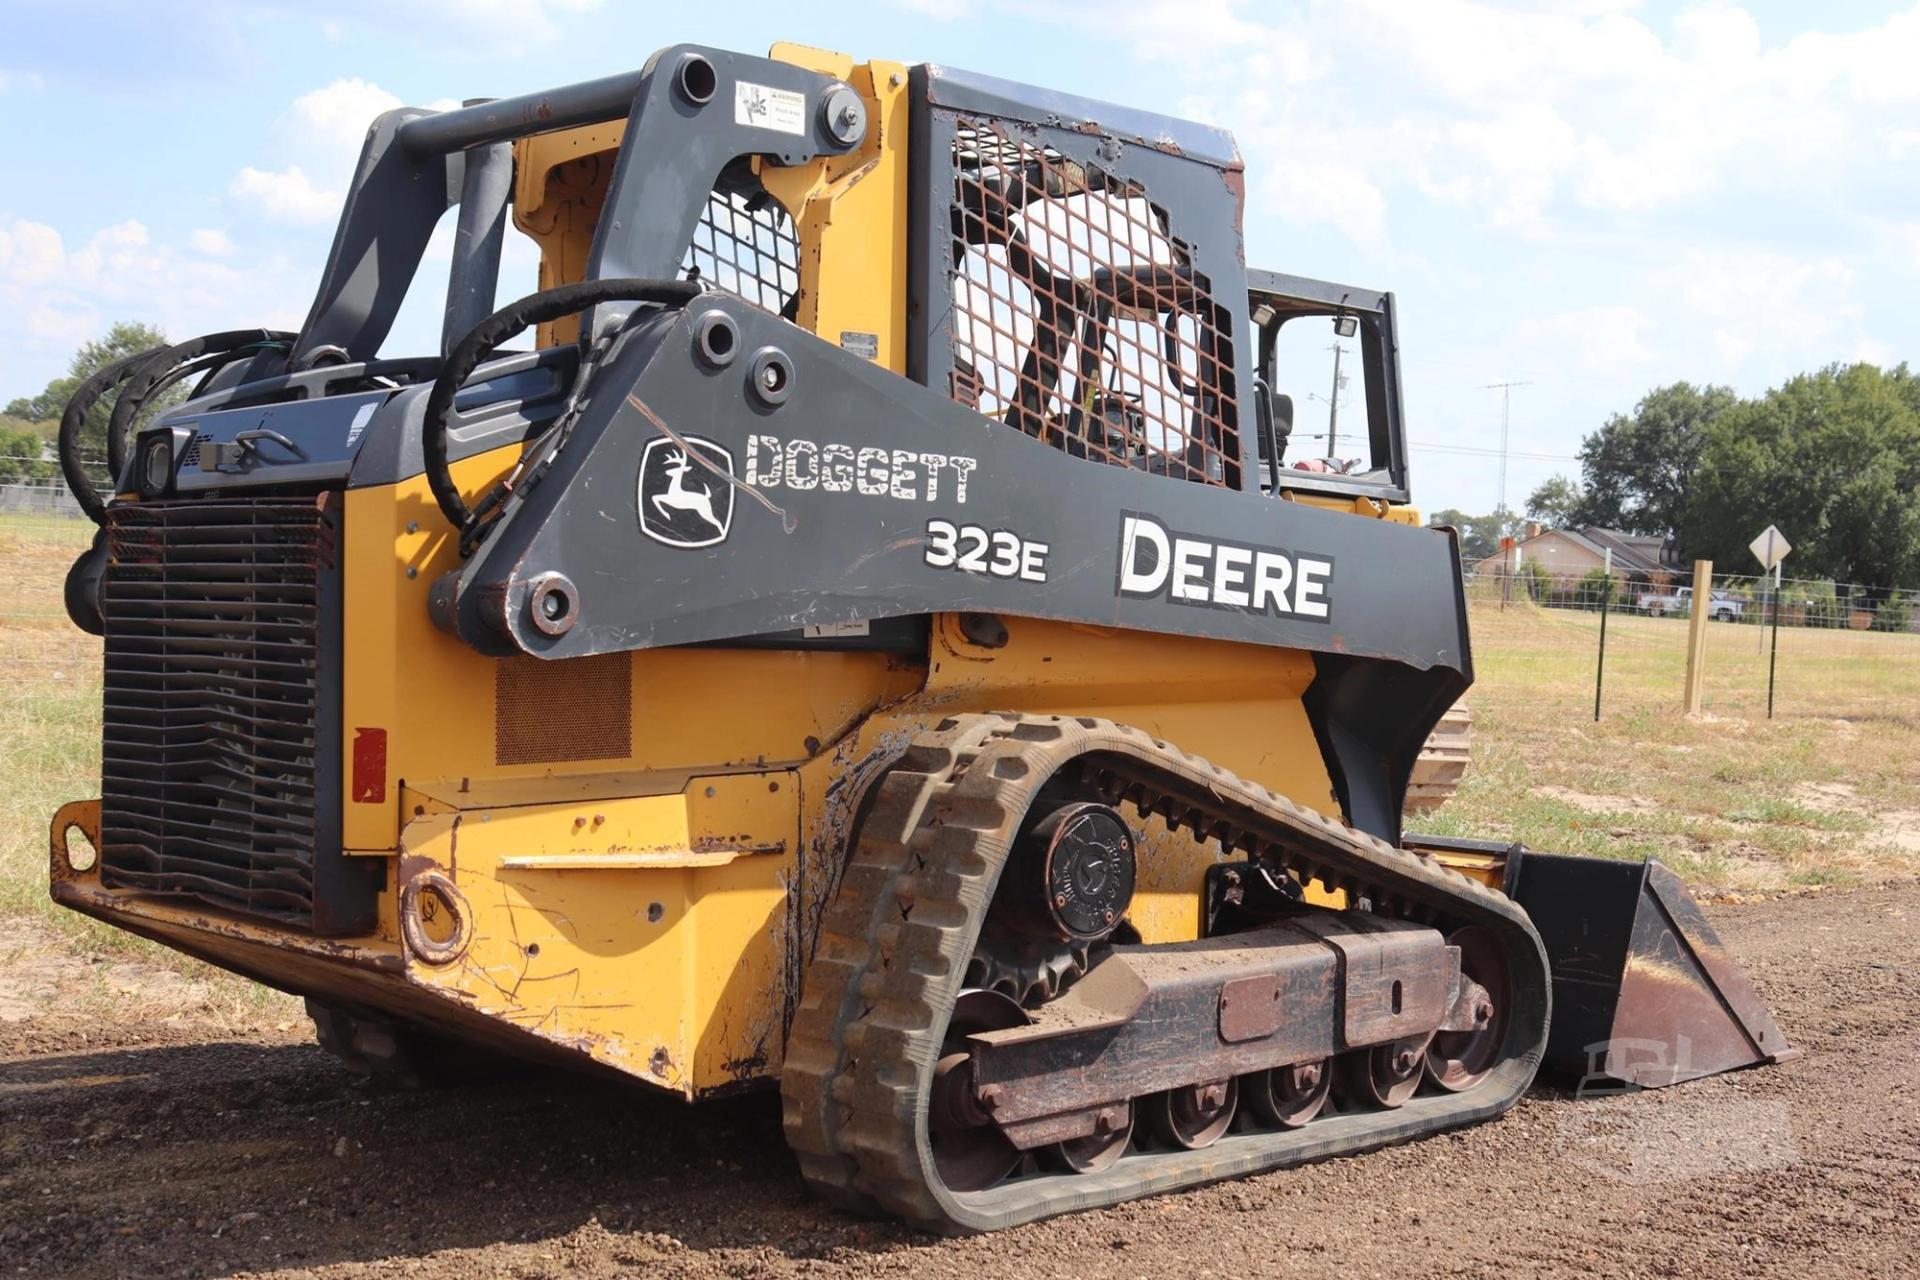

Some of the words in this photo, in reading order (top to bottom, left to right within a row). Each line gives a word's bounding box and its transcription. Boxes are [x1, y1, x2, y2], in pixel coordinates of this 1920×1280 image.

[746, 434, 976, 503] DOGGETT
[925, 520, 1049, 582] 323E
[1120, 516, 1331, 617] DEERE
